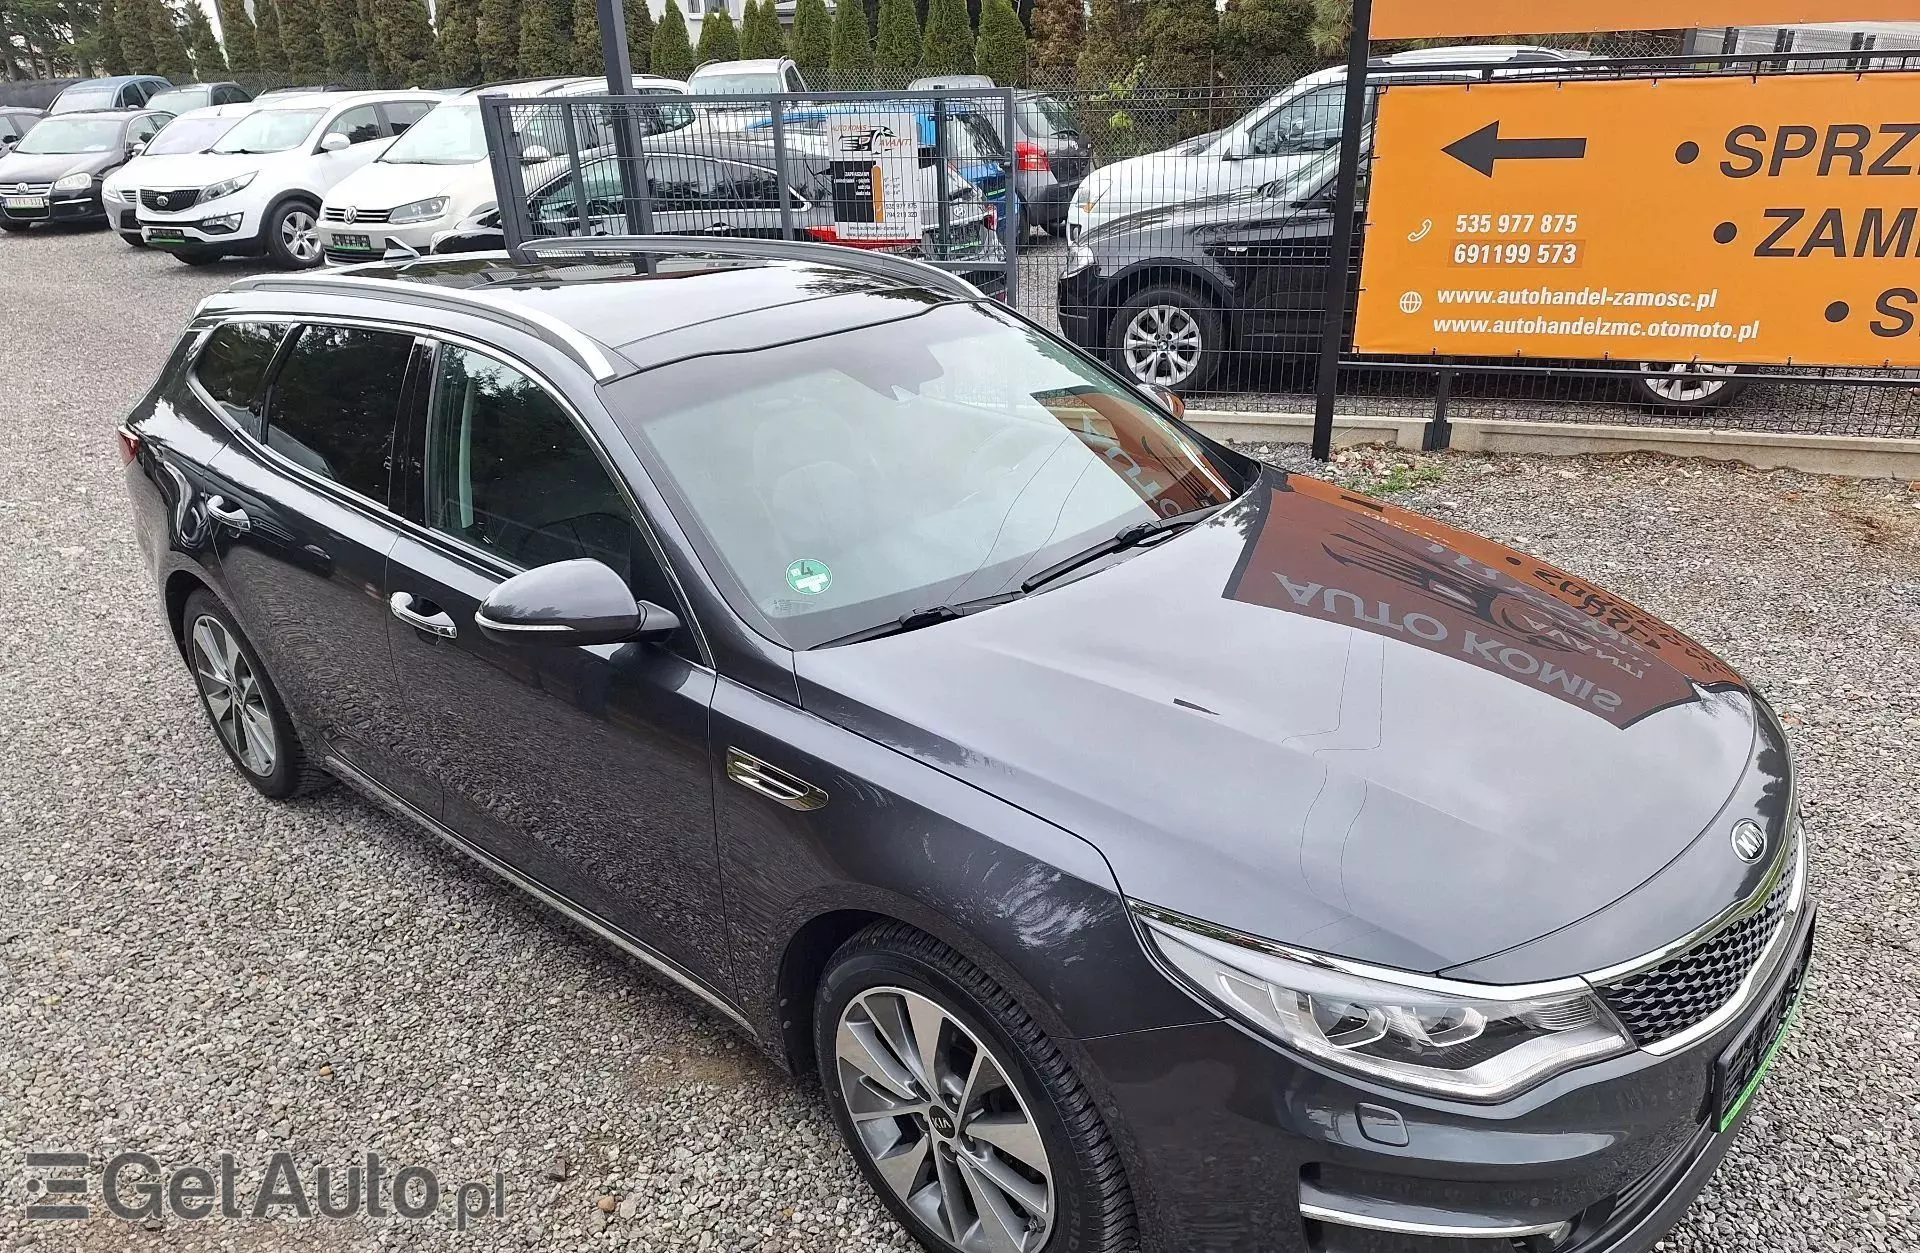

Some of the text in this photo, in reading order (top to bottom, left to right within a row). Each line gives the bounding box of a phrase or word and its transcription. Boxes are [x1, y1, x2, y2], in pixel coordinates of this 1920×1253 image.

[1720, 124, 1920, 178] SPRZ
[1455, 214, 1577, 233] 535 977 875
[1754, 208, 1920, 257] ZAM
[1536, 243, 1577, 264] 573
[1437, 287, 1718, 312] www.autohandel-zamosc.pl
[1869, 288, 1920, 337] S
[1433, 316, 1760, 342] www.autohandelzmc.otomoto.pl
[931, 1117, 951, 1129] KIA
